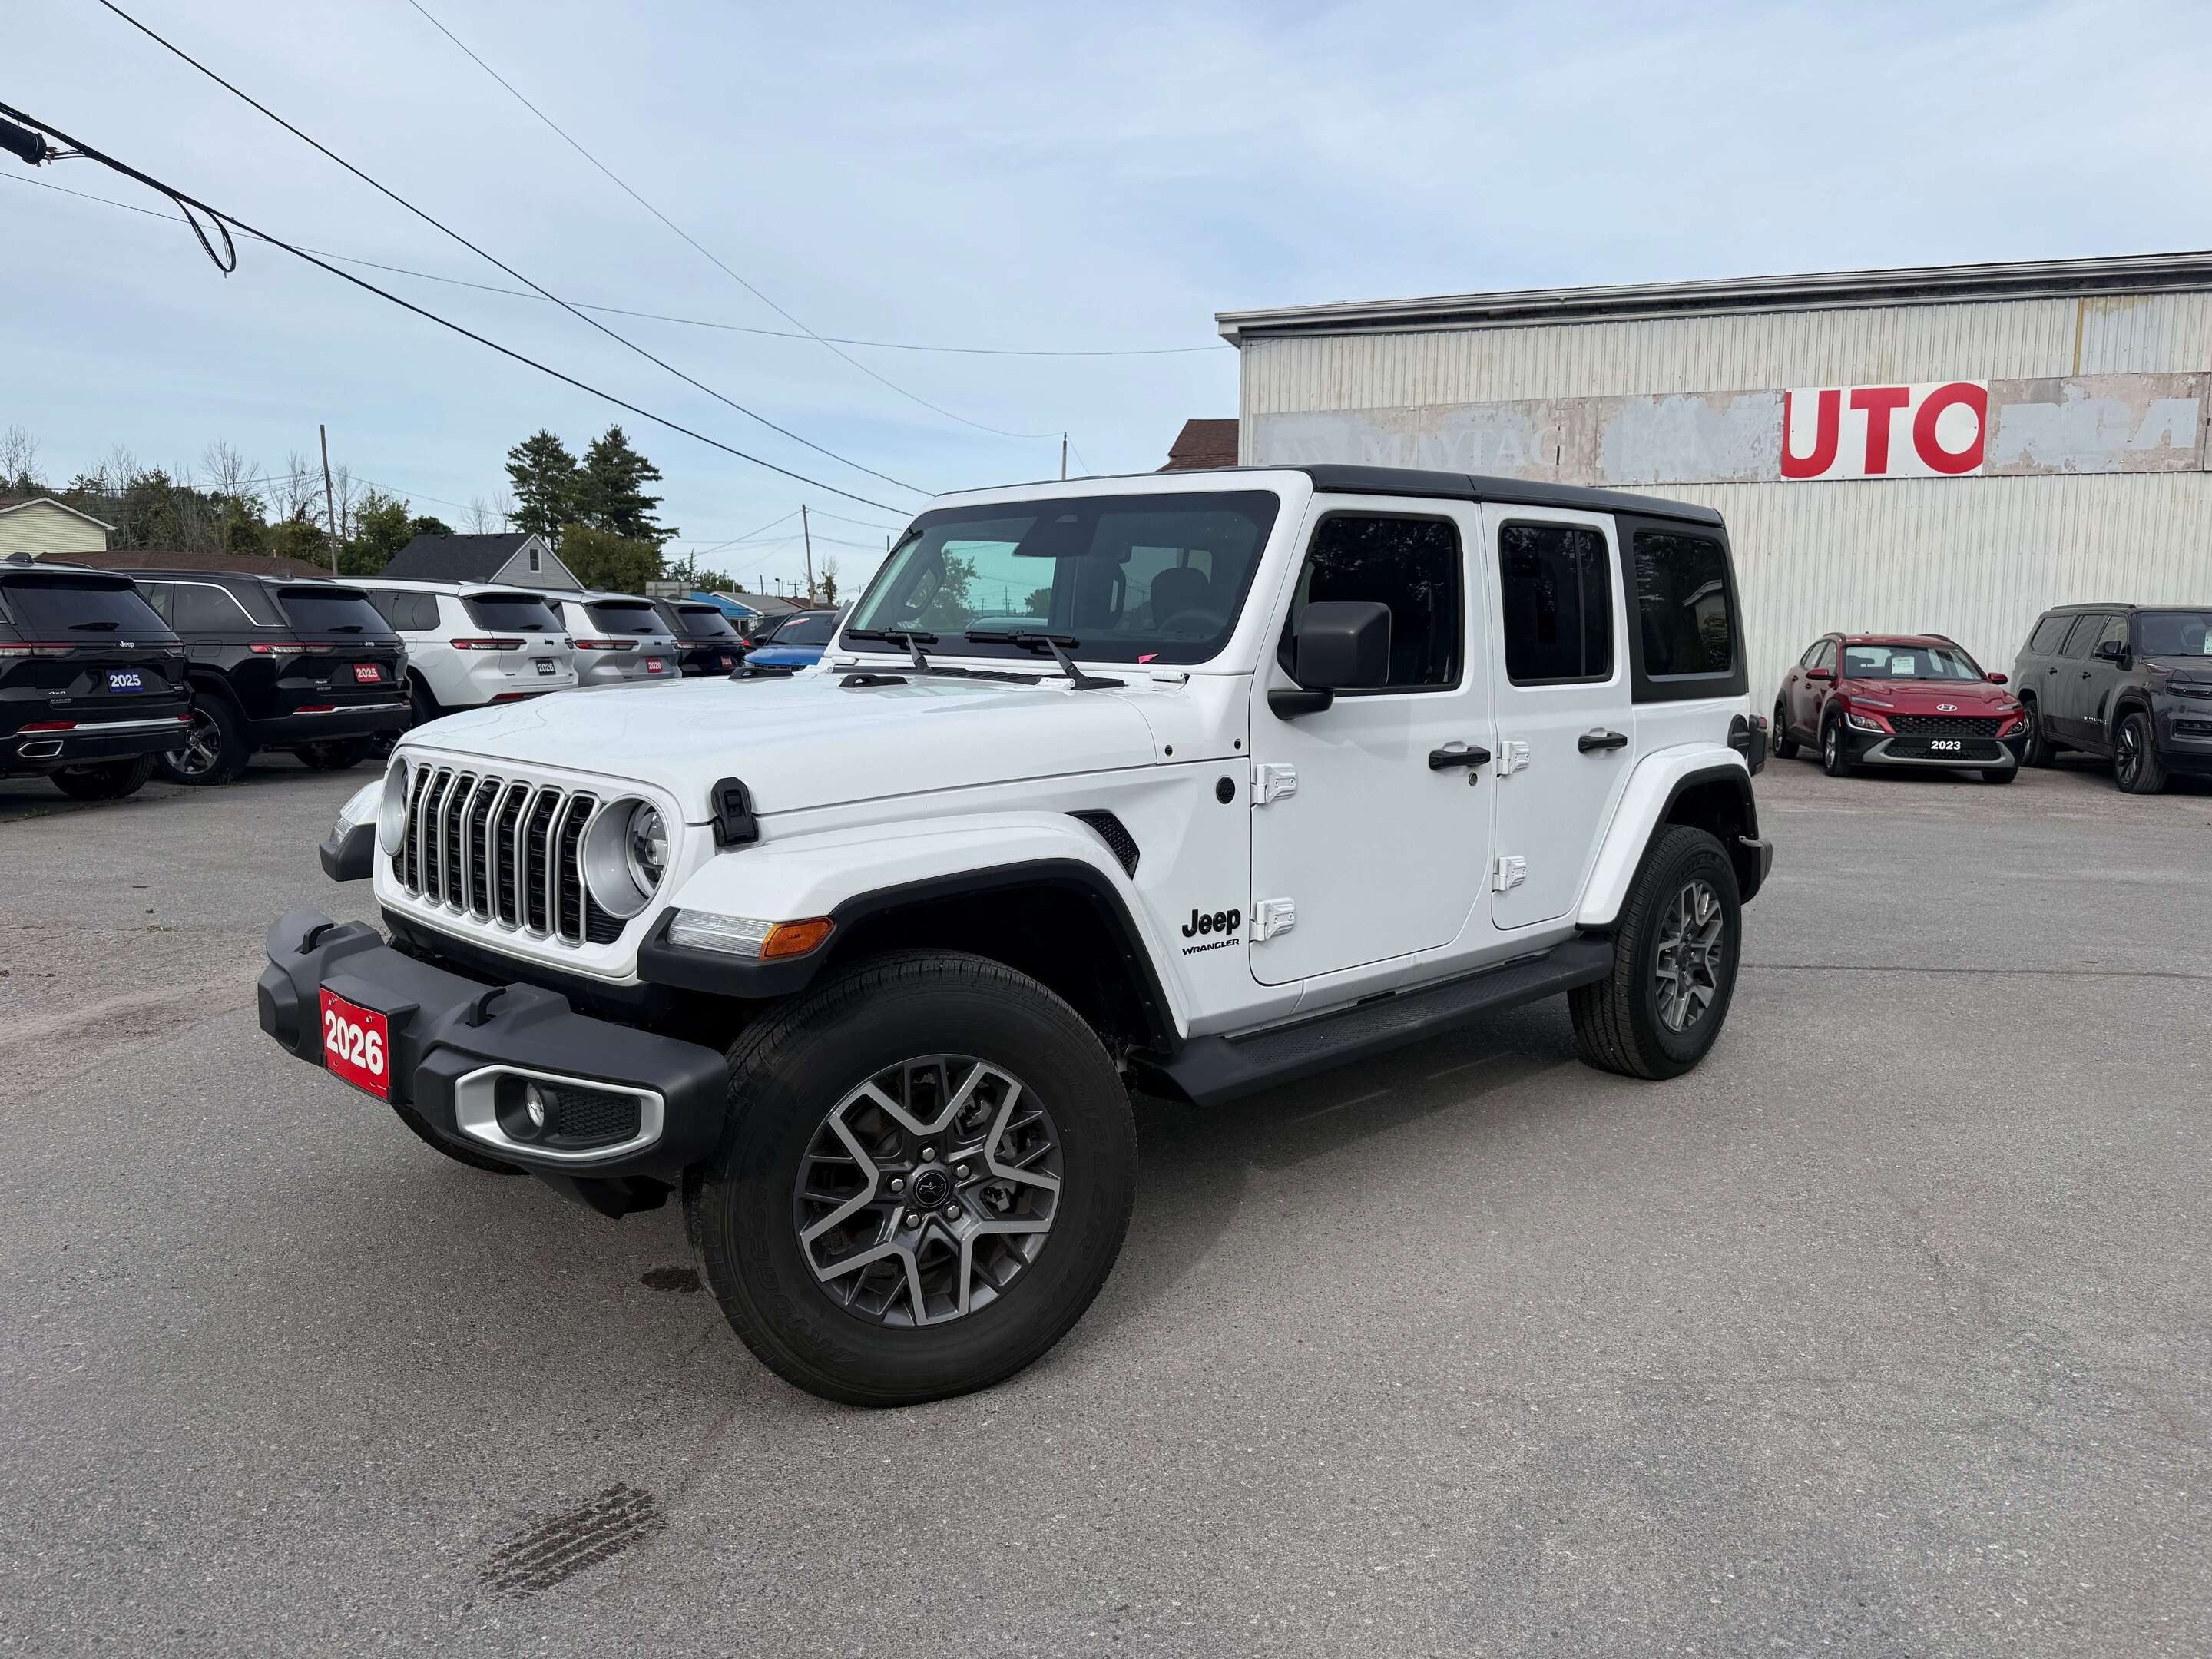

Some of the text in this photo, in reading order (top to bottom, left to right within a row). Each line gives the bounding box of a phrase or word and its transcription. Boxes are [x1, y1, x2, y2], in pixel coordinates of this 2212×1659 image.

[120, 641, 135, 649] Jeep
[356, 668, 379, 678] 2025
[538, 663, 554, 672] 2026
[109, 674, 141, 687] 2025
[1930, 740, 1961, 750] 2023
[1181, 909, 1241, 938] Jeep
[1181, 939, 1240, 955] WRANGLER
[325, 1009, 384, 1075] 2026
